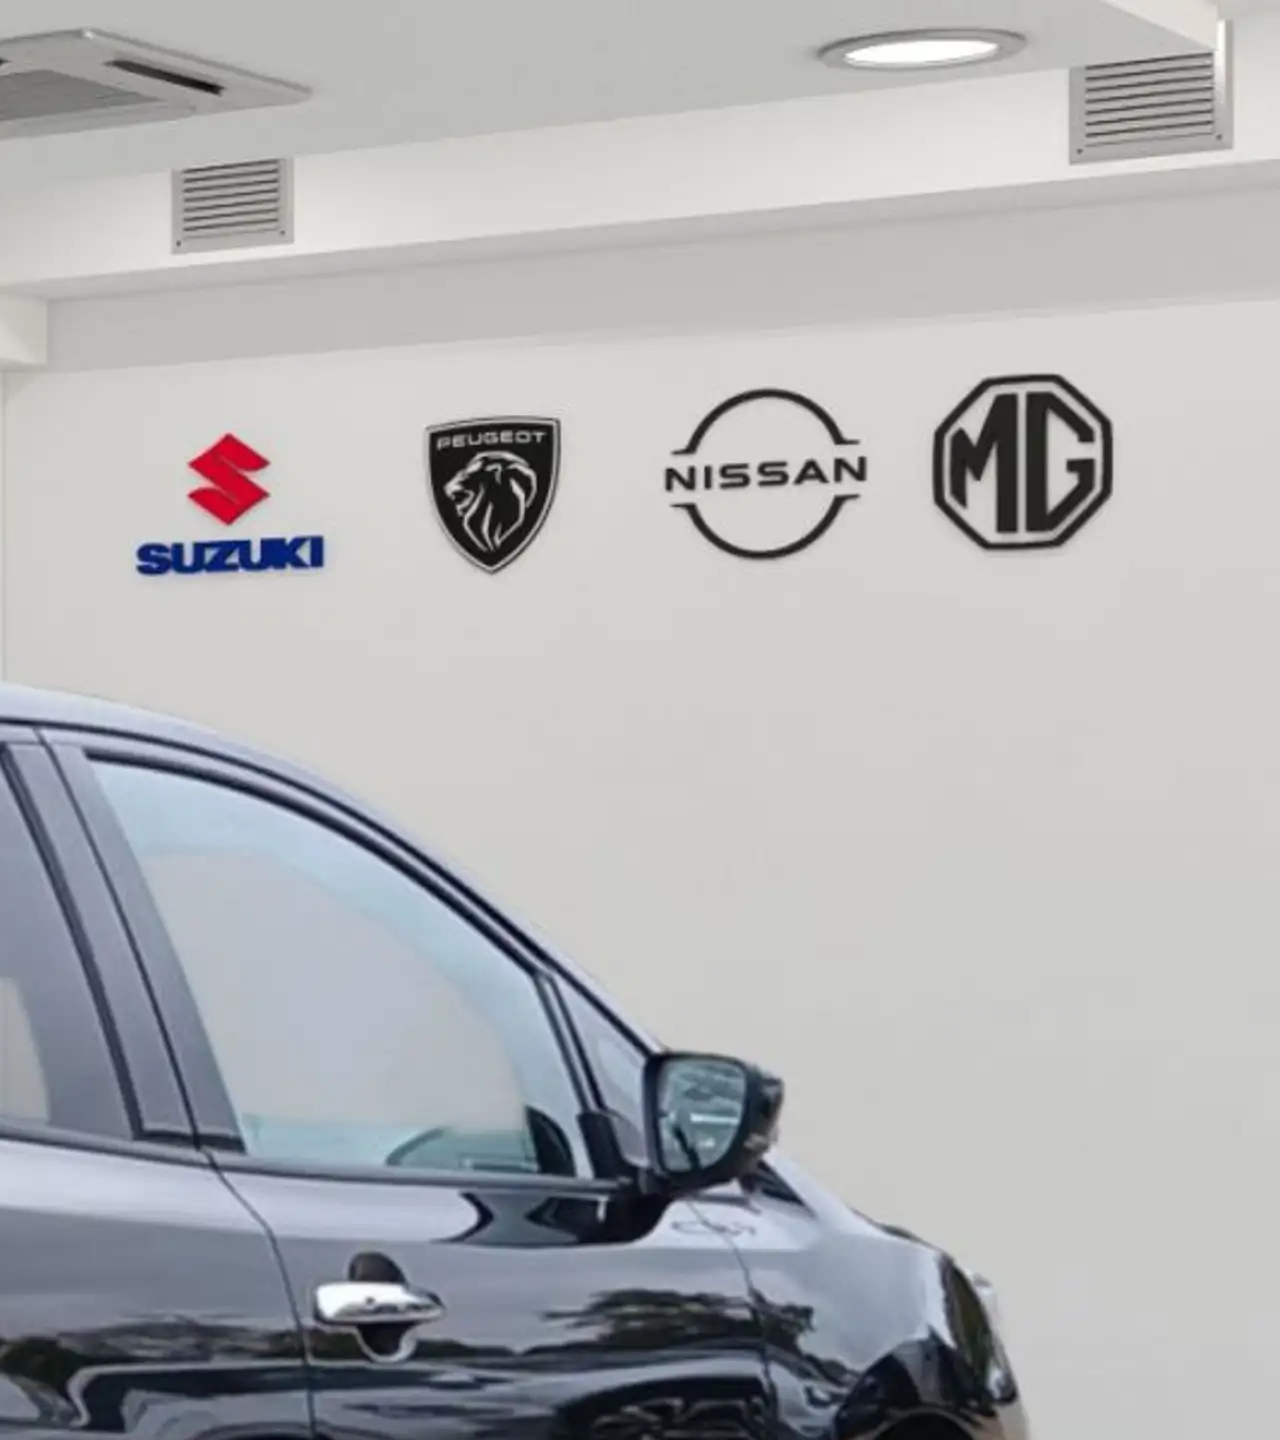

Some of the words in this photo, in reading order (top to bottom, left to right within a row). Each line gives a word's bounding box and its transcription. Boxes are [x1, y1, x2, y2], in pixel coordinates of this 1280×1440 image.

[436, 429, 548, 450] PEUGEOT
[664, 456, 867, 494] NISSAN
[948, 391, 1098, 536] MG
[135, 535, 324, 576] SUZUKI
